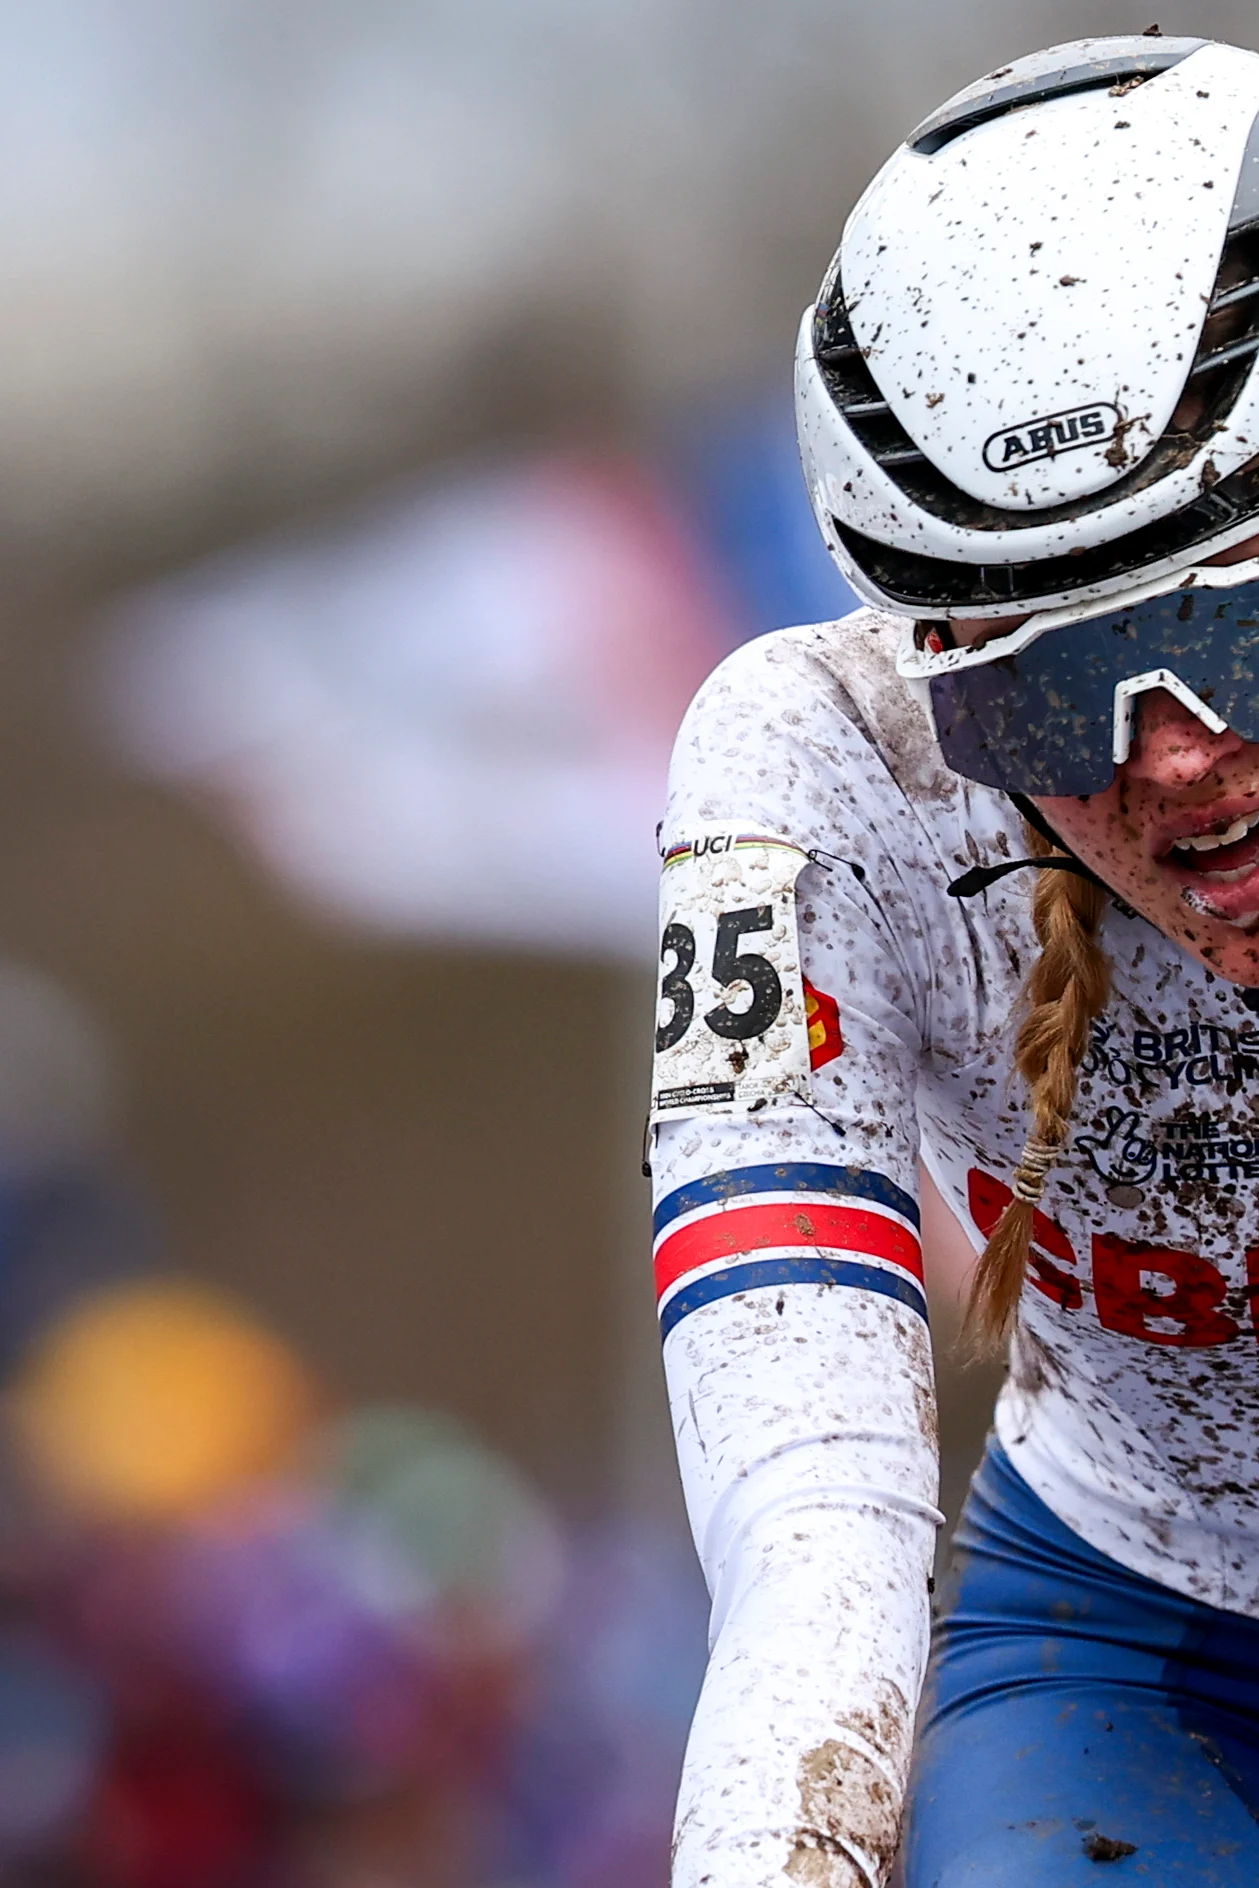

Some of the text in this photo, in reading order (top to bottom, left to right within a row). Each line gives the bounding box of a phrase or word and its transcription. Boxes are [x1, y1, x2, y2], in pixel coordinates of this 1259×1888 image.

[1002, 411, 1105, 462] ABUS
[693, 834, 733, 857] UCI
[655, 904, 783, 1054] 35
[1160, 1121, 1221, 1140] THE
